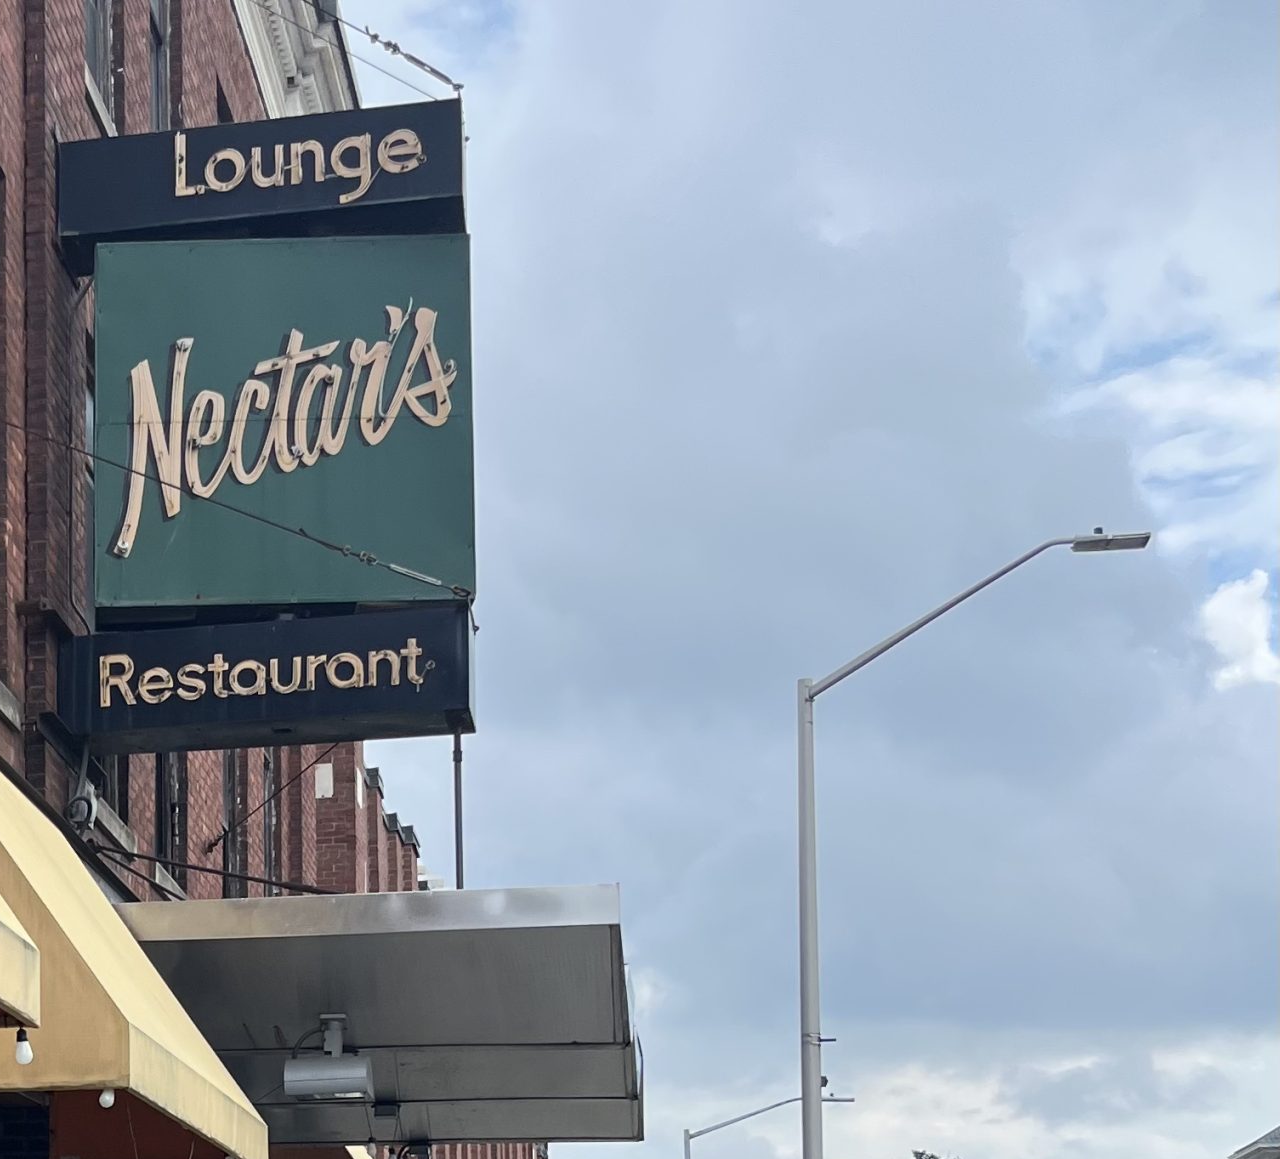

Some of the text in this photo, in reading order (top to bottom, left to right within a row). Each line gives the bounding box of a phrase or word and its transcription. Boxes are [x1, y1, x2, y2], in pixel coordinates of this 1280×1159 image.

[174, 128, 426, 204] Lounge
[113, 299, 457, 558] Nectar's
[99, 637, 426, 708] Restaurant
